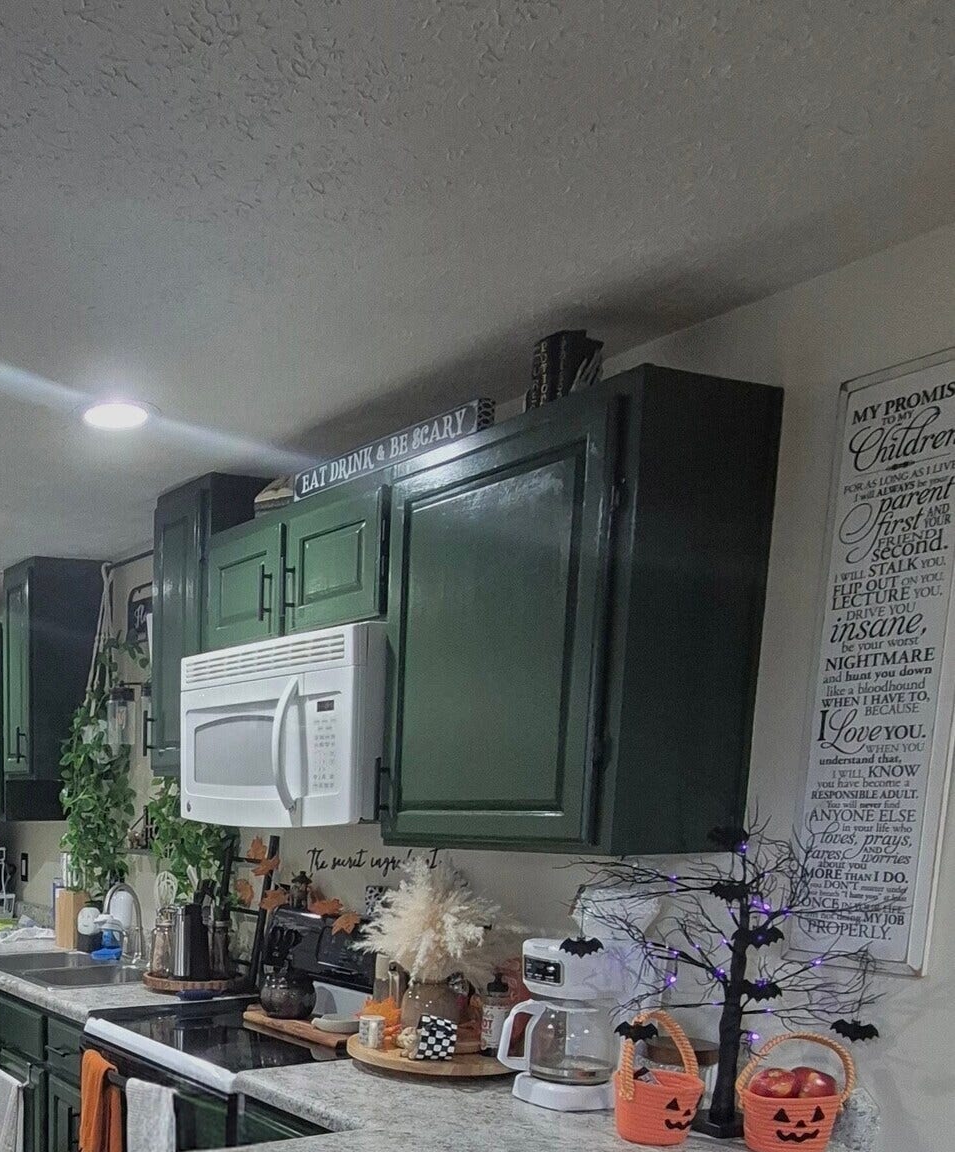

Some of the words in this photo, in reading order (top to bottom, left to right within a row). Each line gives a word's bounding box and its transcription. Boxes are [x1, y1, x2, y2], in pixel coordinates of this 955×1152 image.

[852, 403, 882, 425] MY
[884, 381, 955, 416] PROMIS
[882, 415, 896, 425] TO
[897, 410, 915, 420] MY
[301, 464, 328, 494] EAT
[330, 446, 374, 481] DRINK
[376, 445, 385, 461] &
[389, 433, 408, 459] BE
[411, 408, 467, 450] SCARY
[844, 482, 863, 494] FOR
[867, 480, 877, 489] AS
[880, 472, 909, 485] LONG
[910, 468, 925, 480] AS
[878, 481, 915, 496] ALWAYS
[917, 479, 927, 488] be
[926, 503, 950, 517] AND
[925, 514, 951, 528] YOUR
[871, 528, 948, 562] second.
[841, 570, 865, 580] WILL
[868, 556, 919, 577] STALK
[834, 581, 863, 597] FLIP
[866, 575, 900, 591] OUT
[901, 576, 918, 586] ON
[832, 586, 910, 610] LECTURE
[846, 606, 886, 621] DRIVE
[889, 602, 916, 616] YOU
[830, 612, 927, 643] insane,
[841, 641, 854, 653] be
[857, 640, 885, 655] your
[887, 636, 919, 647] worst
[825, 647, 935, 672] NIGHTMARE
[823, 671, 842, 684] and
[845, 670, 872, 681] hunt
[874, 669, 896, 682] you
[899, 665, 932, 676] down
[826, 685, 846, 697] like
[858, 676, 926, 694] bloodhound
[821, 696, 860, 708] WHEN
[871, 692, 905, 705] HAVE
[865, 702, 920, 716] BECAUSE
[816, 709, 830, 741] I
[820, 708, 883, 755] Love
[884, 724, 926, 740] YOU.
[866, 744, 899, 753] WHEN
[902, 742, 925, 752] YOU
[819, 754, 875, 766] understand
[838, 769, 864, 778] WILL
[868, 764, 921, 778] KNOW
[817, 780, 835, 791] you
[837, 778, 859, 787] have
[863, 778, 901, 787] become
[811, 790, 879, 800] RESPONSIBLE
[812, 808, 875, 821] ANYONE
[879, 809, 917, 822] ELSE
[842, 824, 851, 832] in
[854, 825, 873, 834] your
[876, 823, 890, 832] life
[893, 824, 913, 833] who
[819, 821, 858, 846] loves,
[843, 834, 912, 859] prays,
[307, 847, 328, 872] The
[330, 849, 368, 869] secret
[370, 847, 438, 877] ingret
[862, 852, 912, 864] worries
[802, 867, 842, 879] MORE
[844, 873, 872, 881] THAN
[882, 871, 908, 883] DO.
[848, 863, 867, 872] you
[824, 880, 860, 890] DON'T
[802, 897, 839, 909] ONCE
[863, 912, 882, 923] MY
[884, 914, 905, 926] JOB
[808, 919, 891, 940] PROPERLY.
